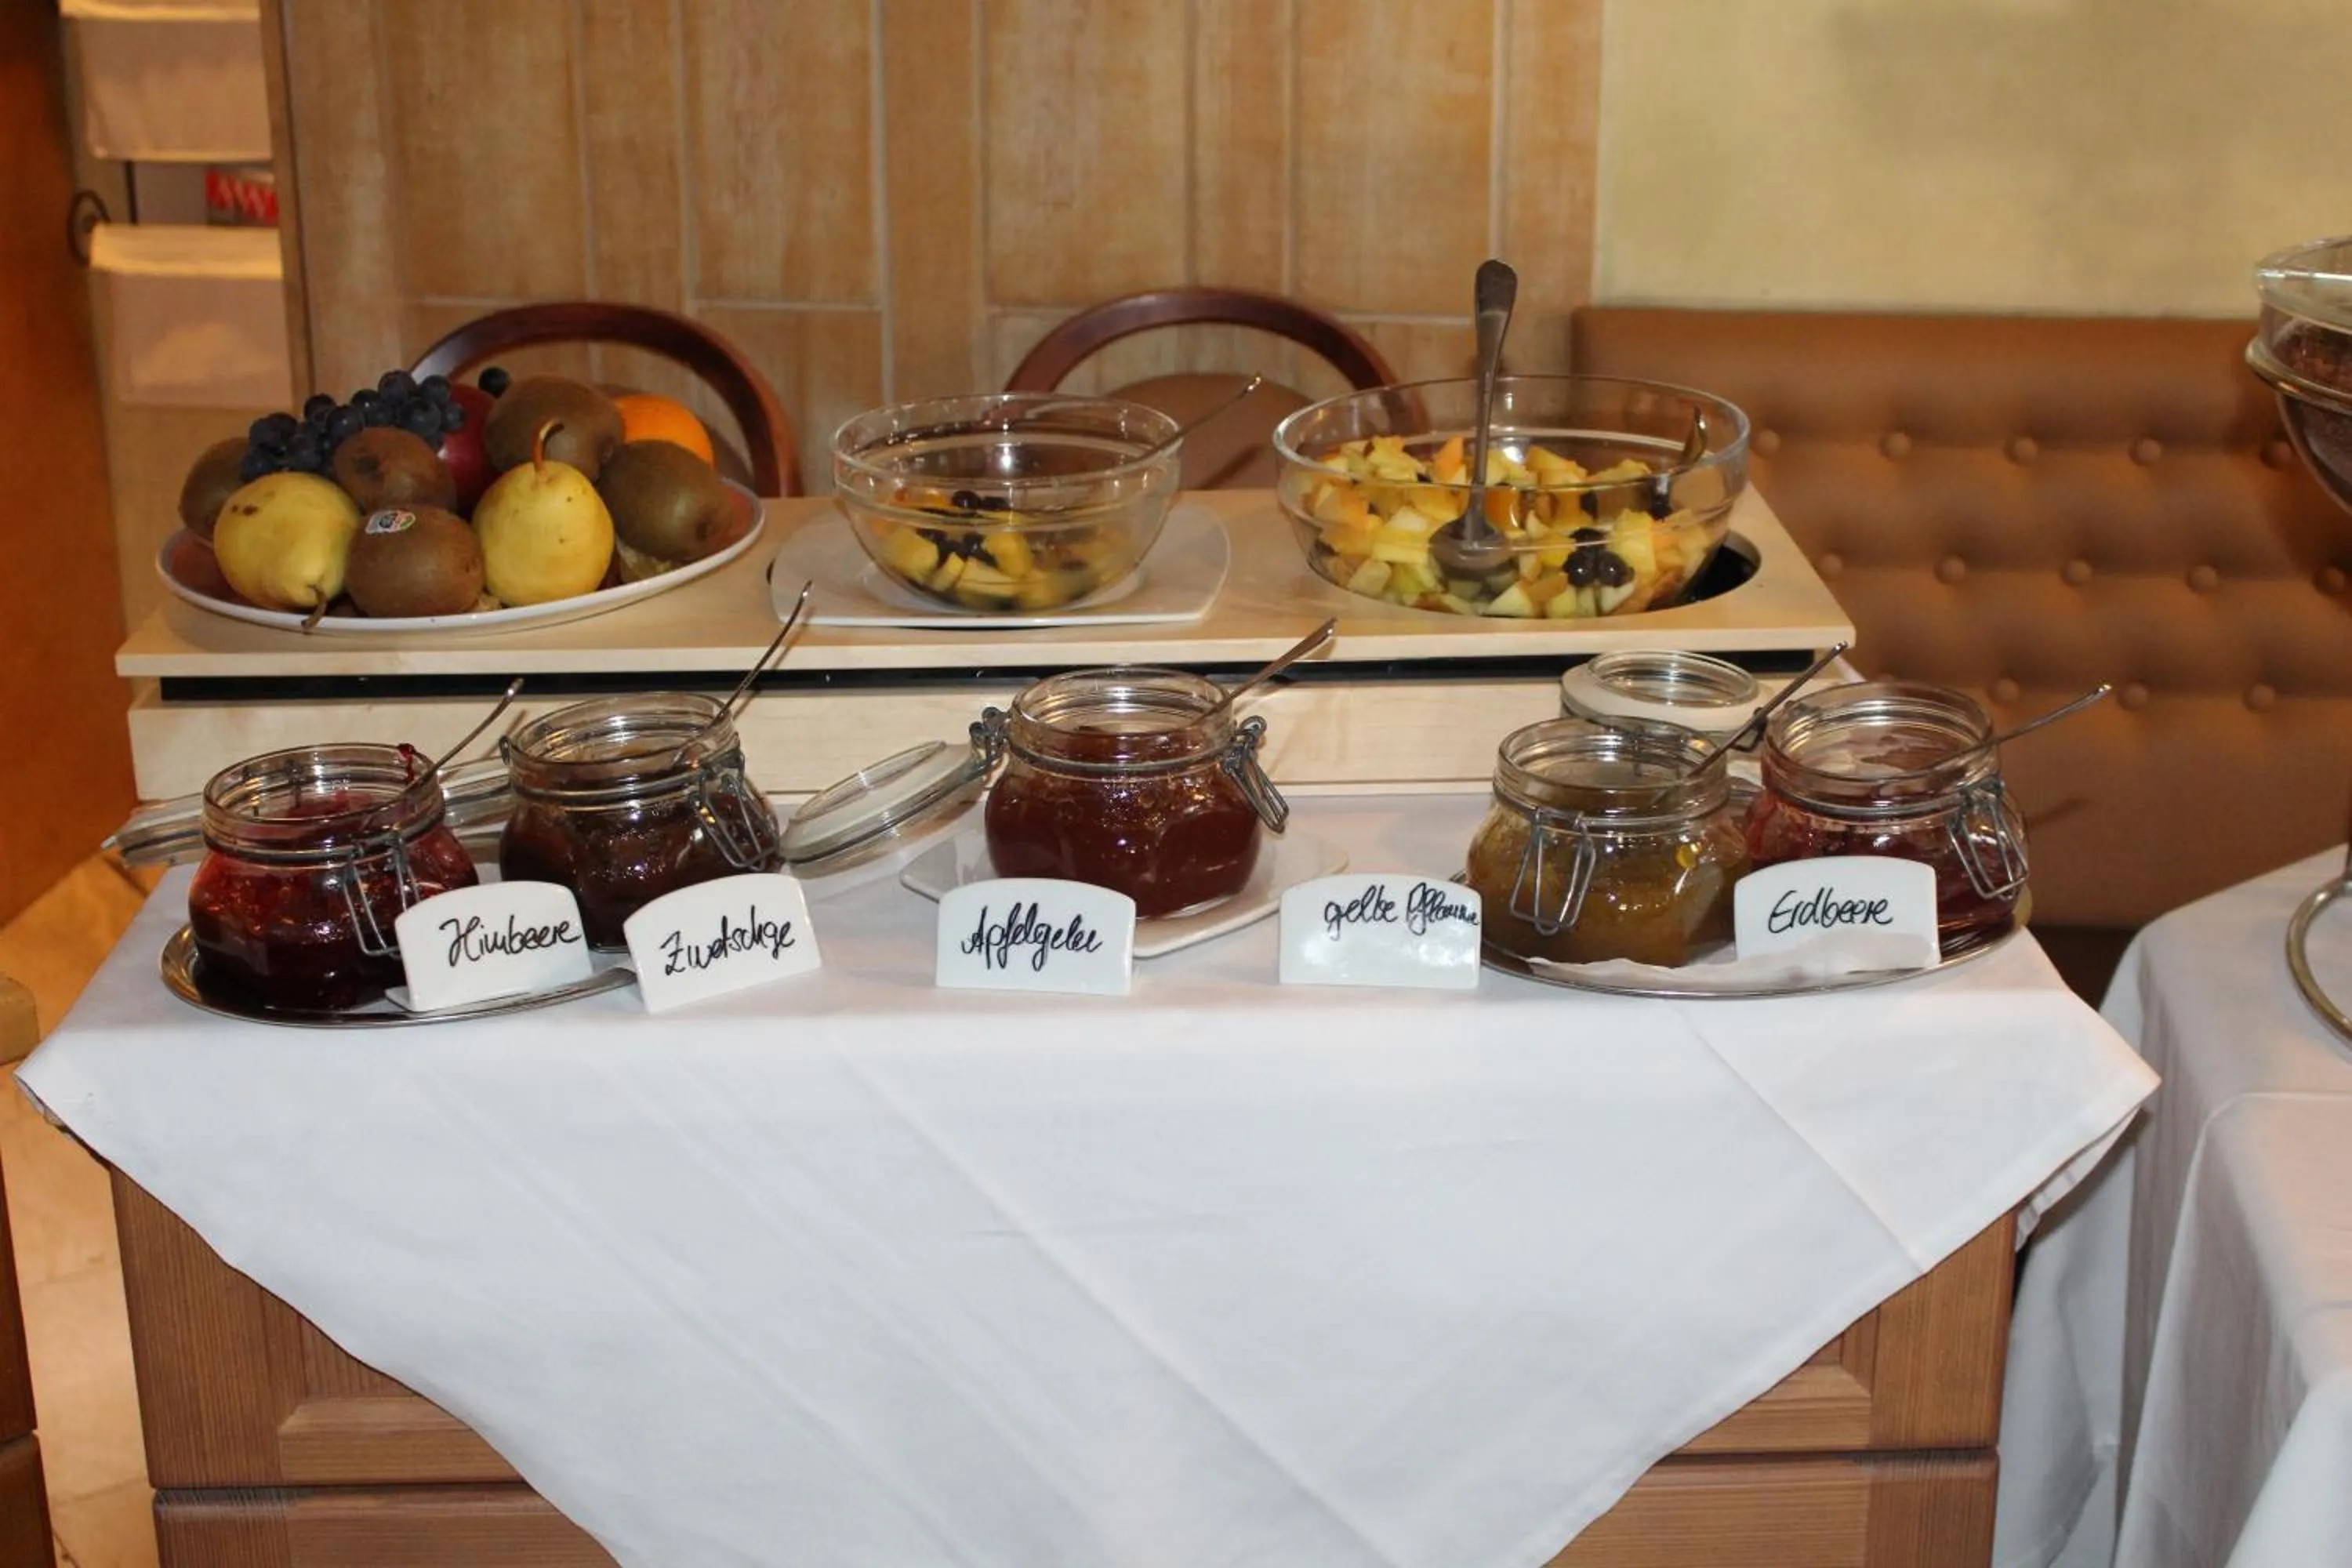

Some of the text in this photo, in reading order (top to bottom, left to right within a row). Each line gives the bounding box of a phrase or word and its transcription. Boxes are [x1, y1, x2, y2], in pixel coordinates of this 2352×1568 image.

[960, 902, 1103, 972] Apfelgelee
[1323, 884, 1399, 941] gelbe
[1767, 887, 1893, 934] Erdbeere
[439, 914, 582, 967] Himbeere
[659, 905, 795, 976] Zwetschge
